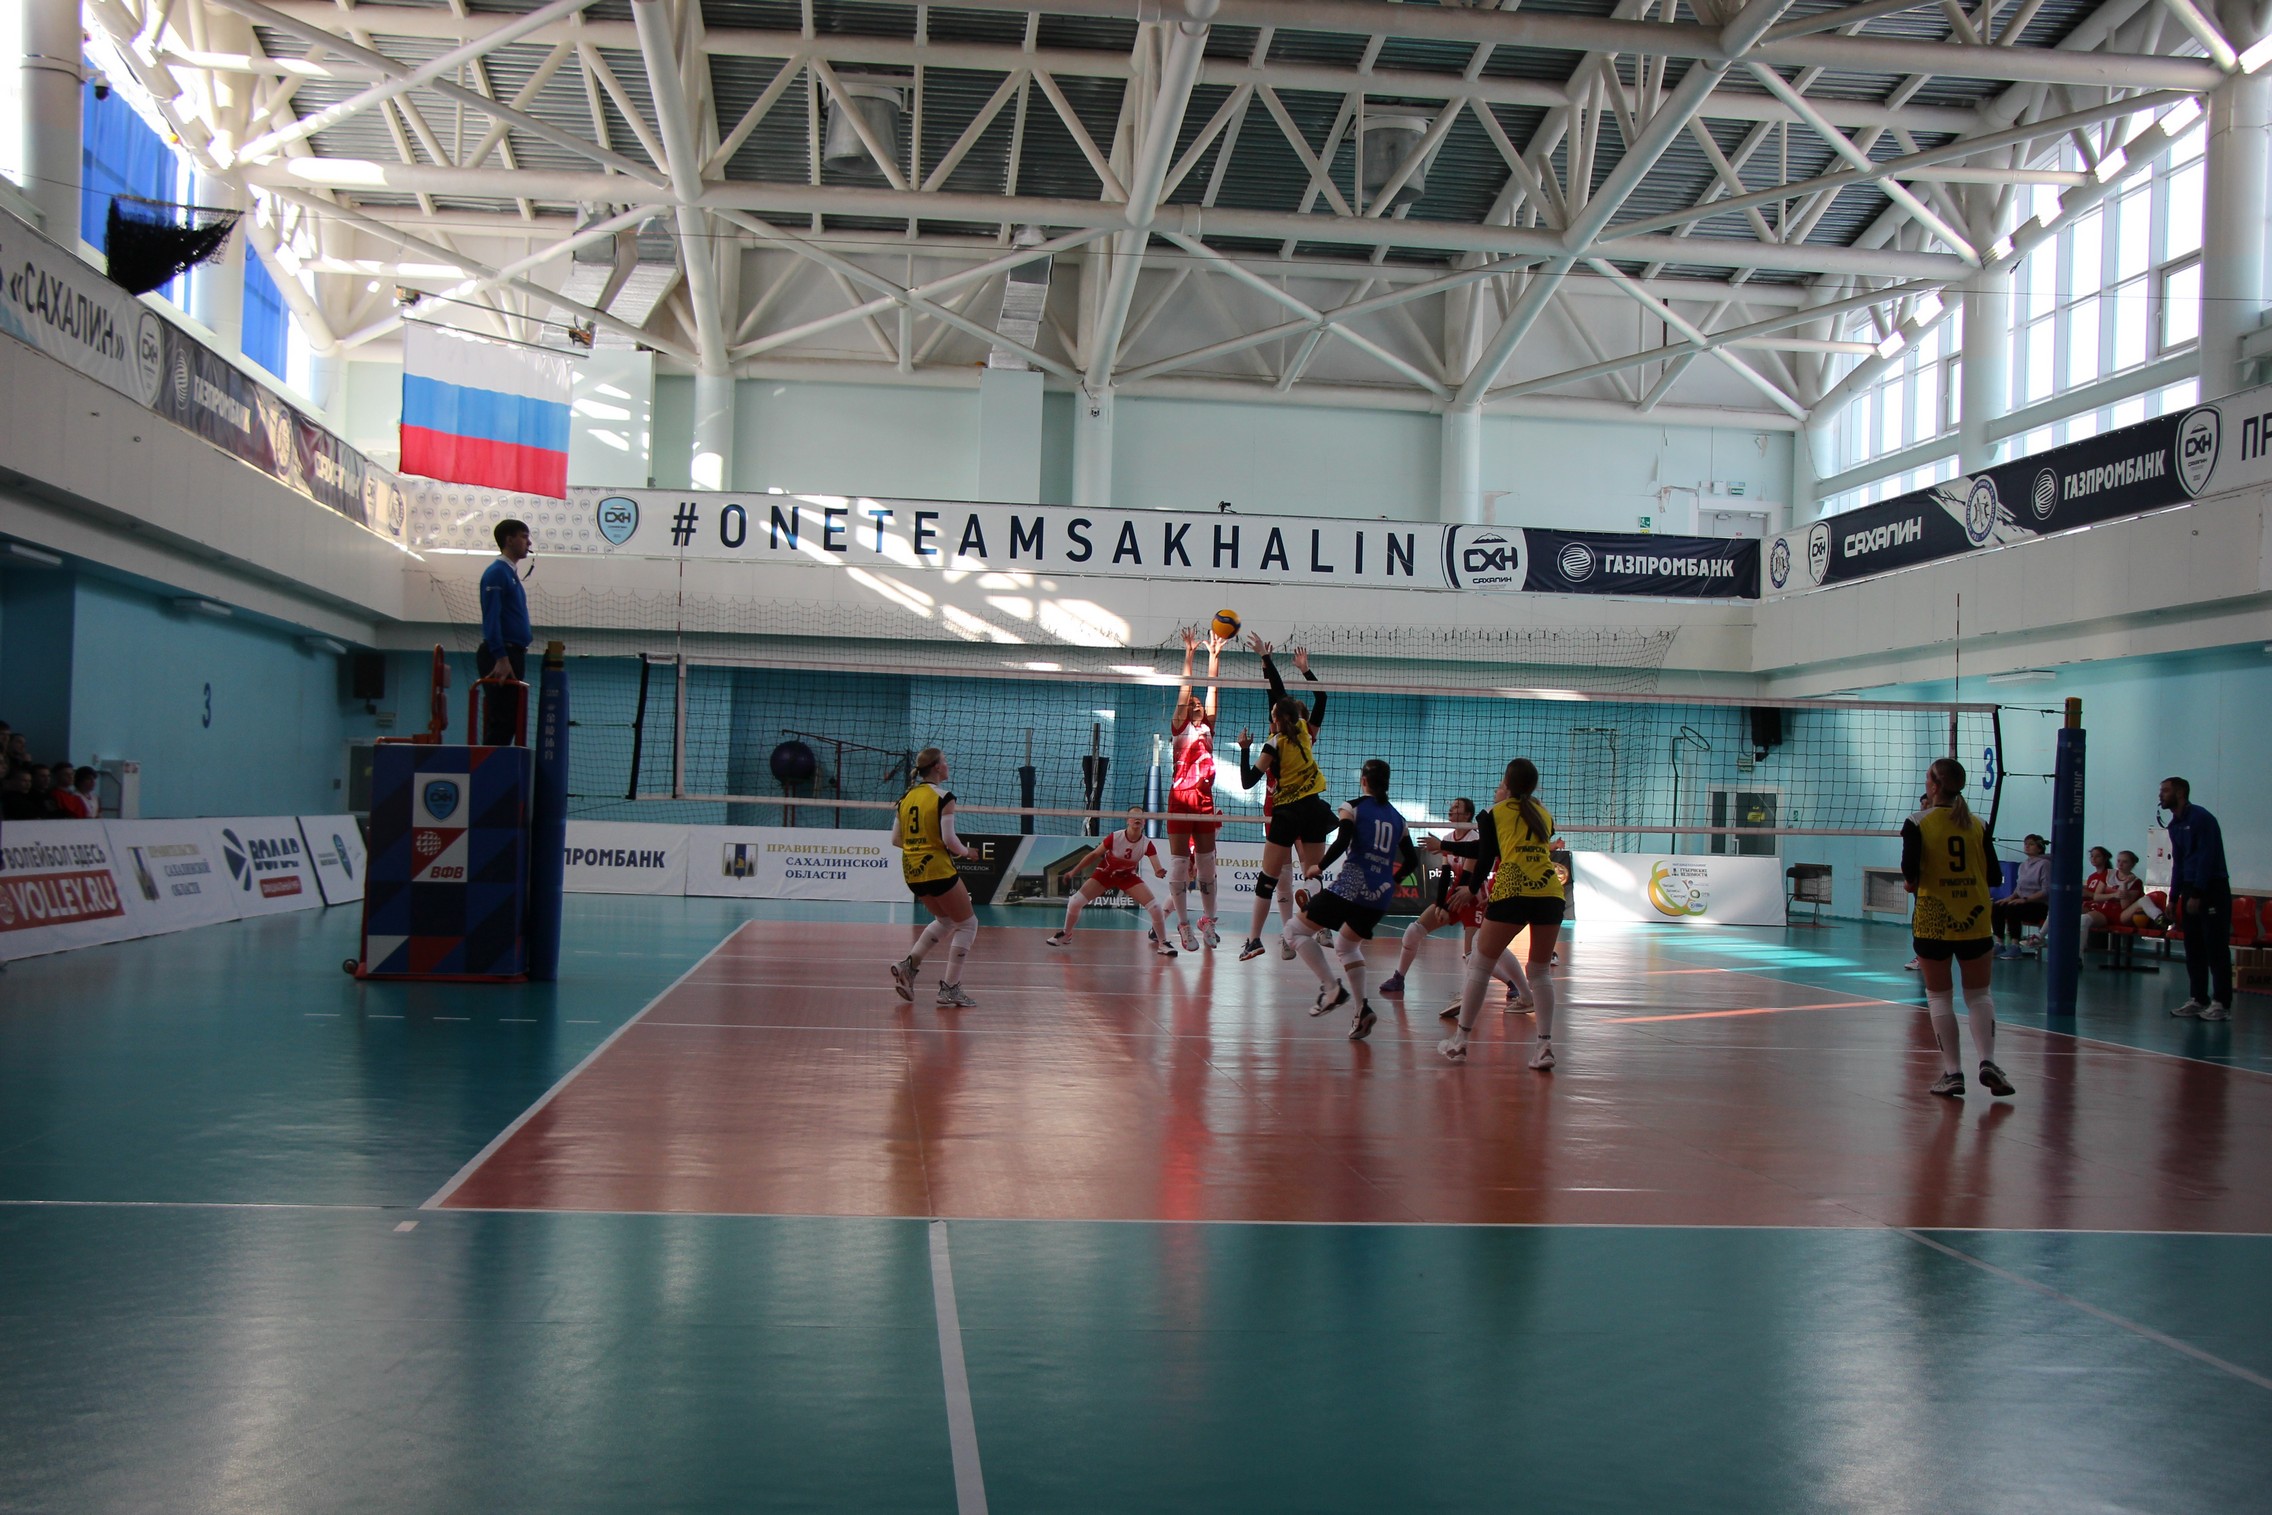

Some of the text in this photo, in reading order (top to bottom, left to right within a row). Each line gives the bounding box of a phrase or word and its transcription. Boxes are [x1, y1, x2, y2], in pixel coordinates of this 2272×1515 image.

[10, 261, 125, 361] «САХАЛИН»
[2063, 449, 2166, 500] ГАЗПРОМБАНК
[671, 501, 1416, 577] #ONETEAMSAKHALIN
[1844, 516, 1922, 558] САХАЛИН
[1605, 554, 1735, 577] ГАЗПРОМБАНК
[1472, 576, 1512, 584] САХАЛИН
[202, 681, 212, 729] 3
[1982, 747, 1995, 790] 3
[2073, 770, 2084, 815] JINLING
[910, 805, 919, 834] 3
[1373, 819, 1393, 853] 10
[564, 848, 665, 868] ПРОМБАНК
[766, 843, 881, 856] ПРАВИТЕЛЬСТВО
[785, 856, 889, 868] САХАЛИНСКОЙ
[1124, 848, 1133, 860] 3
[1947, 835, 1966, 872] 9
[430, 865, 464, 879] ВФВ
[785, 869, 847, 880] ОБЛАСТИ
[1428, 867, 1457, 879] piza.
[8, 876, 117, 920] VOLLEY.RU
[1088, 896, 1135, 906] ДУЩЕЕ
[1475, 910, 1483, 924] 5
